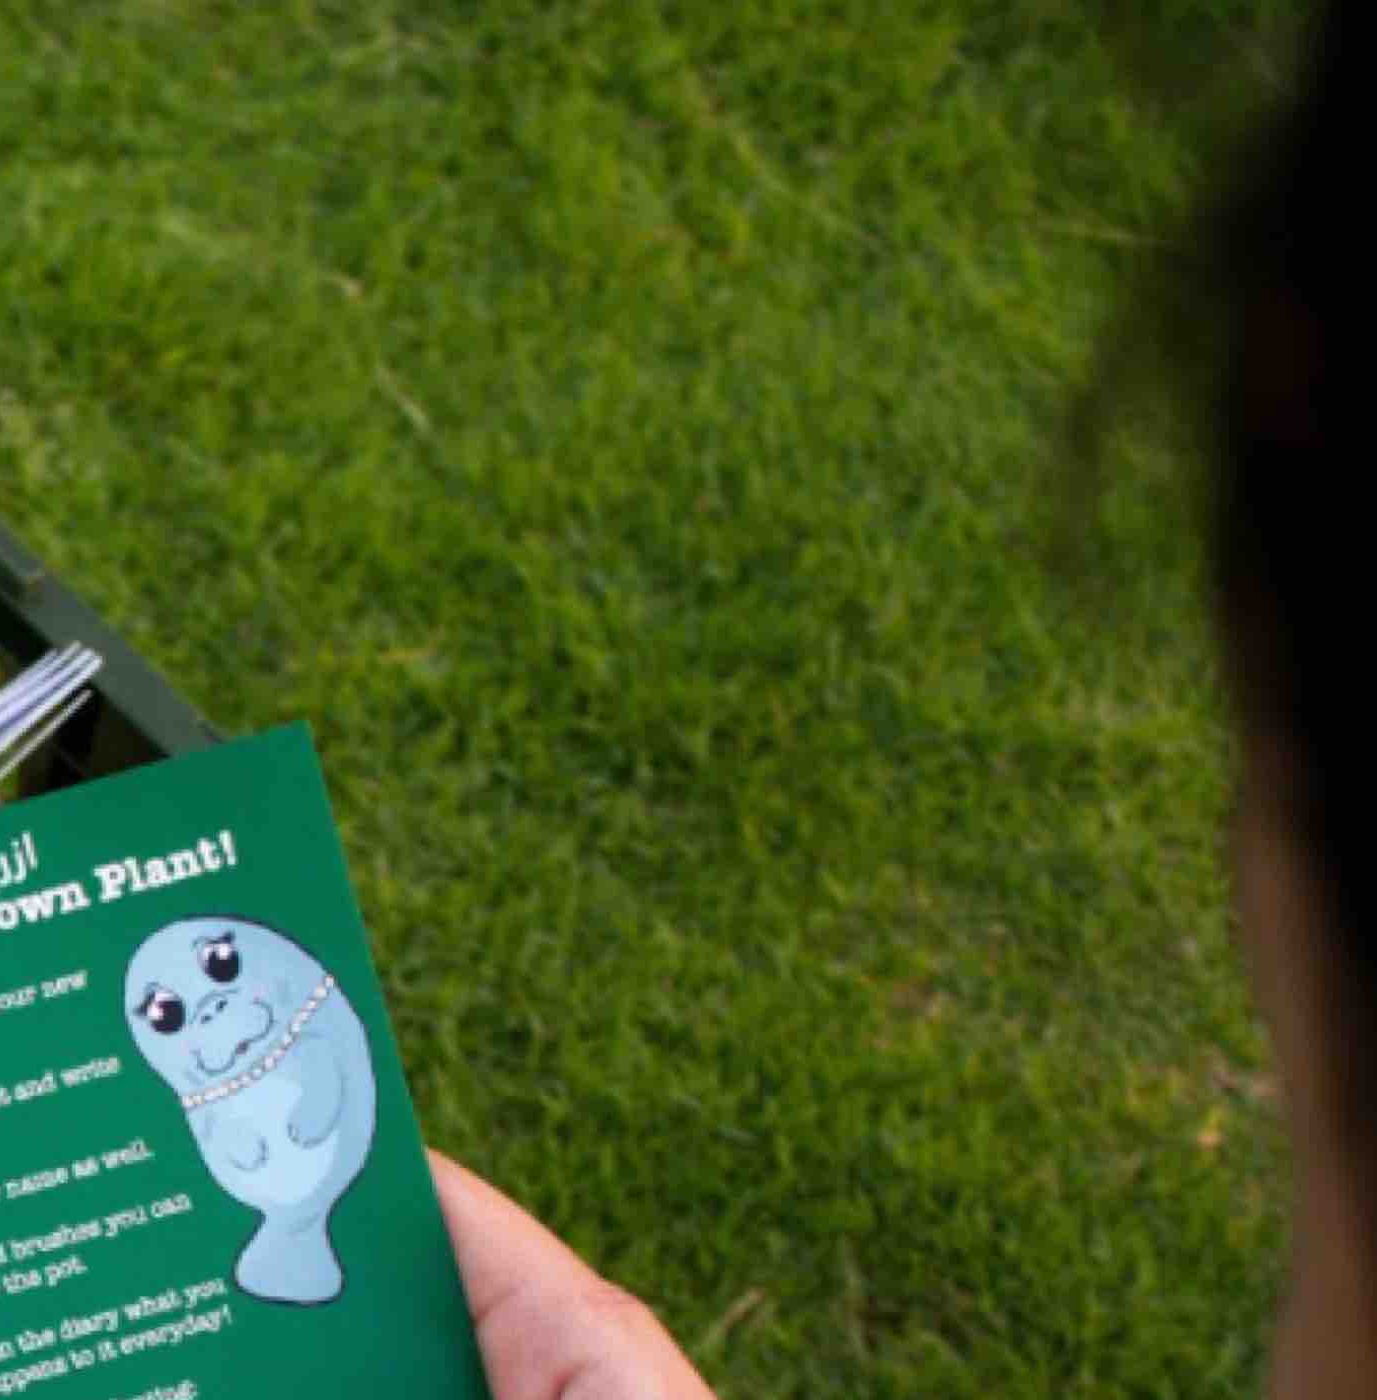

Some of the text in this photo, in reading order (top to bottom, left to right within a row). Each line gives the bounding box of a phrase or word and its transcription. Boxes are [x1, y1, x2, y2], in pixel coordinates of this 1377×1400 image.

[93, 830, 236, 902] Plant!
[40, 969, 87, 997] new
[12, 1071, 57, 1101] and
[59, 1056, 121, 1087] write
[3, 1167, 69, 1198] name
[71, 1156, 99, 1179] as
[8, 1219, 103, 1260] brushes
[98, 1205, 149, 1237] you
[150, 1193, 191, 1218] can
[1, 1269, 42, 1294] the
[15, 1327, 57, 1353] the
[59, 1308, 118, 1340] diary
[121, 1289, 183, 1320] what
[182, 1278, 227, 1309] you
[66, 1348, 95, 1369] to
[95, 1339, 117, 1361] it
